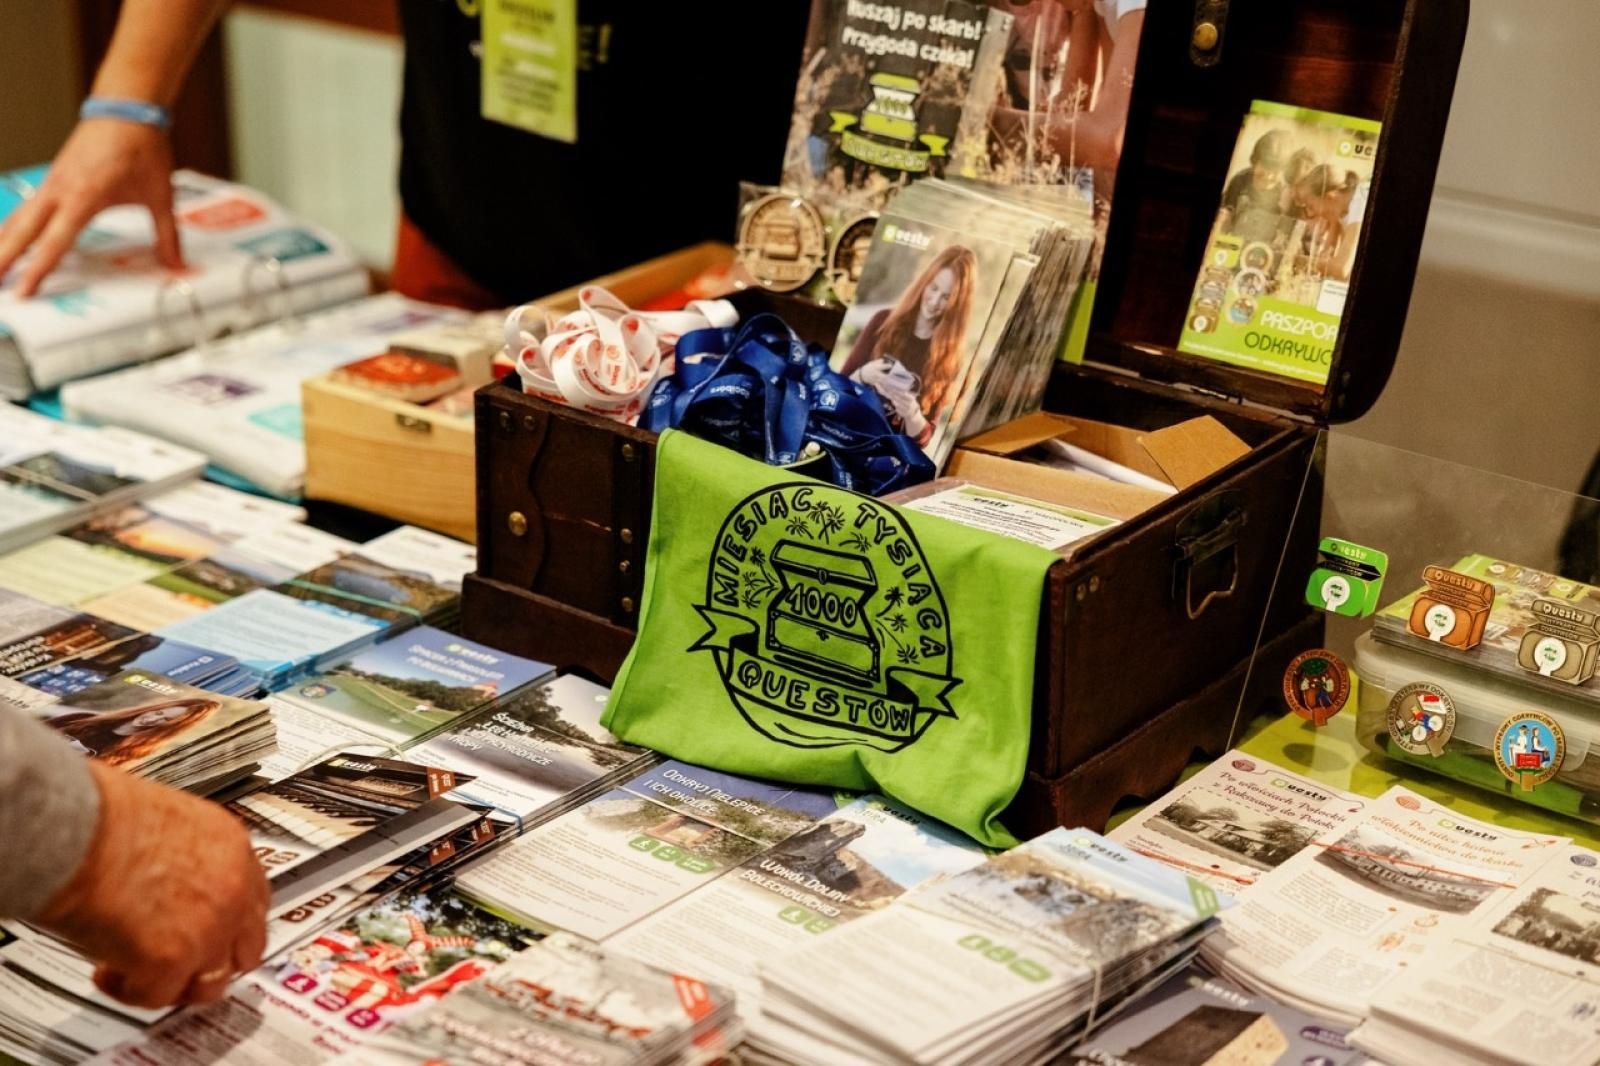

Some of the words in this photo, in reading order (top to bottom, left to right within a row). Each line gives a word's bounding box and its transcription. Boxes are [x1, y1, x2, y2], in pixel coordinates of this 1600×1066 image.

[902, 11, 927, 31] po
[928, 15, 982, 41] skarb!
[842, 26, 918, 59] Przygoda
[920, 44, 975, 69] czeka!
[854, 502, 946, 659] TYSIĄCA
[1434, 569, 1475, 590] Questy
[786, 582, 858, 628] 1000
[1543, 603, 1584, 622] Questy
[737, 659, 911, 732] QUESTÓW
[649, 782, 673, 795] ICH
[1279, 807, 1296, 818] do
[803, 879, 851, 902] DOLINY
